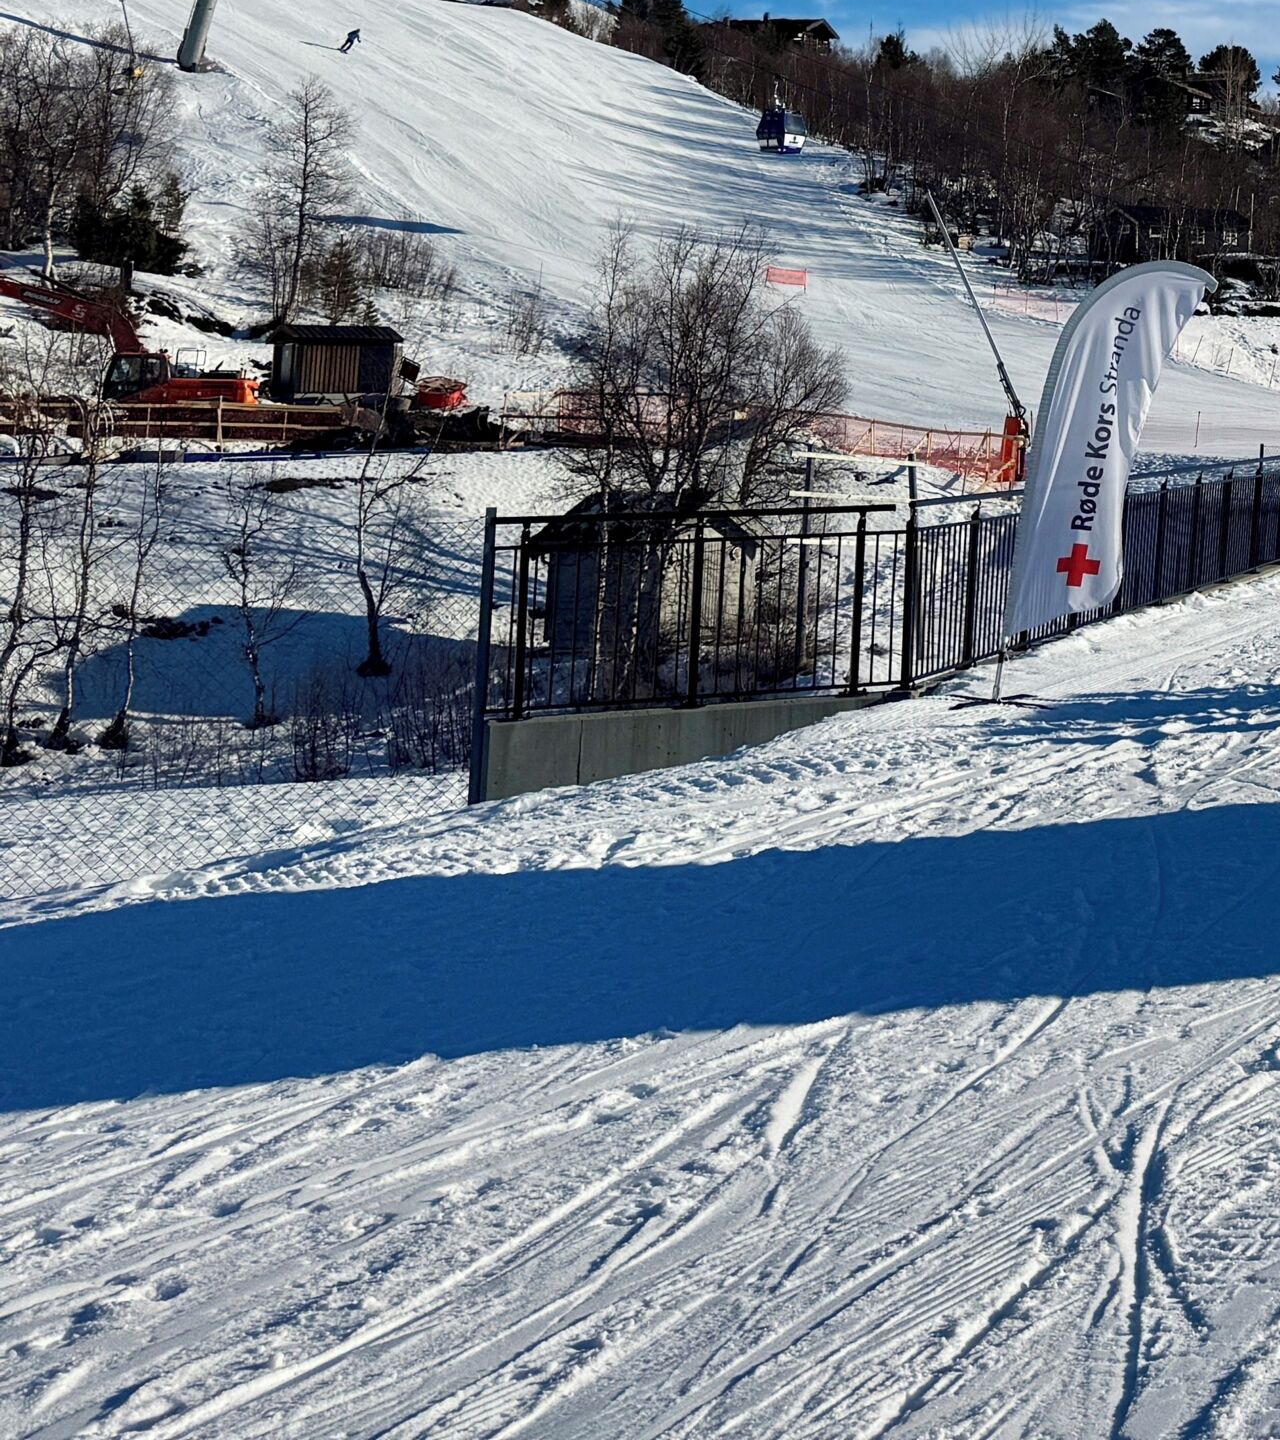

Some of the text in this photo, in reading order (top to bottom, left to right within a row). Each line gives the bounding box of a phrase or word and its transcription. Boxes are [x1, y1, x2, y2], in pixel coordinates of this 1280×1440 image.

[1070, 306, 1142, 531] Røde Kors Stranda
